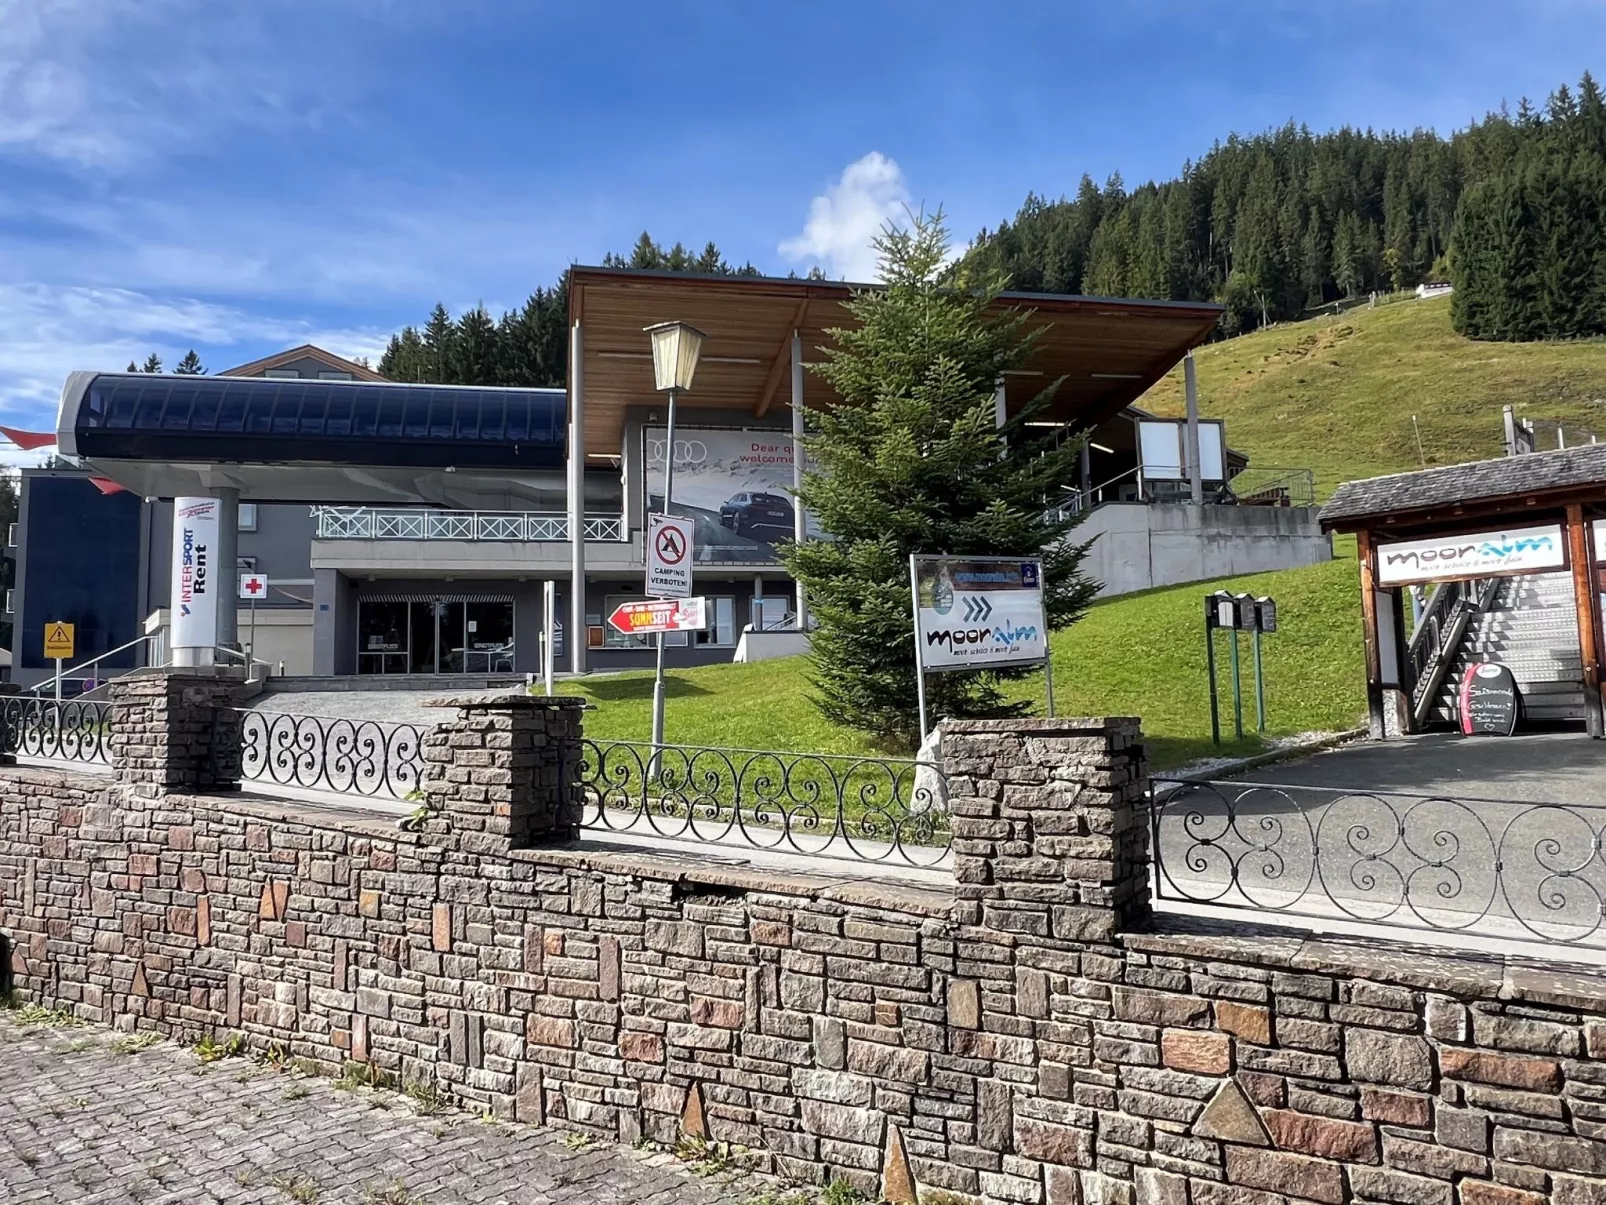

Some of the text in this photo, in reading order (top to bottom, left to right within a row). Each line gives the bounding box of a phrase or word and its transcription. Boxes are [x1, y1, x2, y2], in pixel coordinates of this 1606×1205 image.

[751, 443, 779, 452] Dear
[740, 454, 795, 464] welcome
[1387, 534, 1553, 569] mooralm
[181, 528, 194, 602] INTERSPORT
[193, 544, 207, 594] Rent
[654, 567, 685, 577] CAMPING
[650, 577, 688, 587] VERBOTEN!
[926, 618, 1037, 653] mooralm
